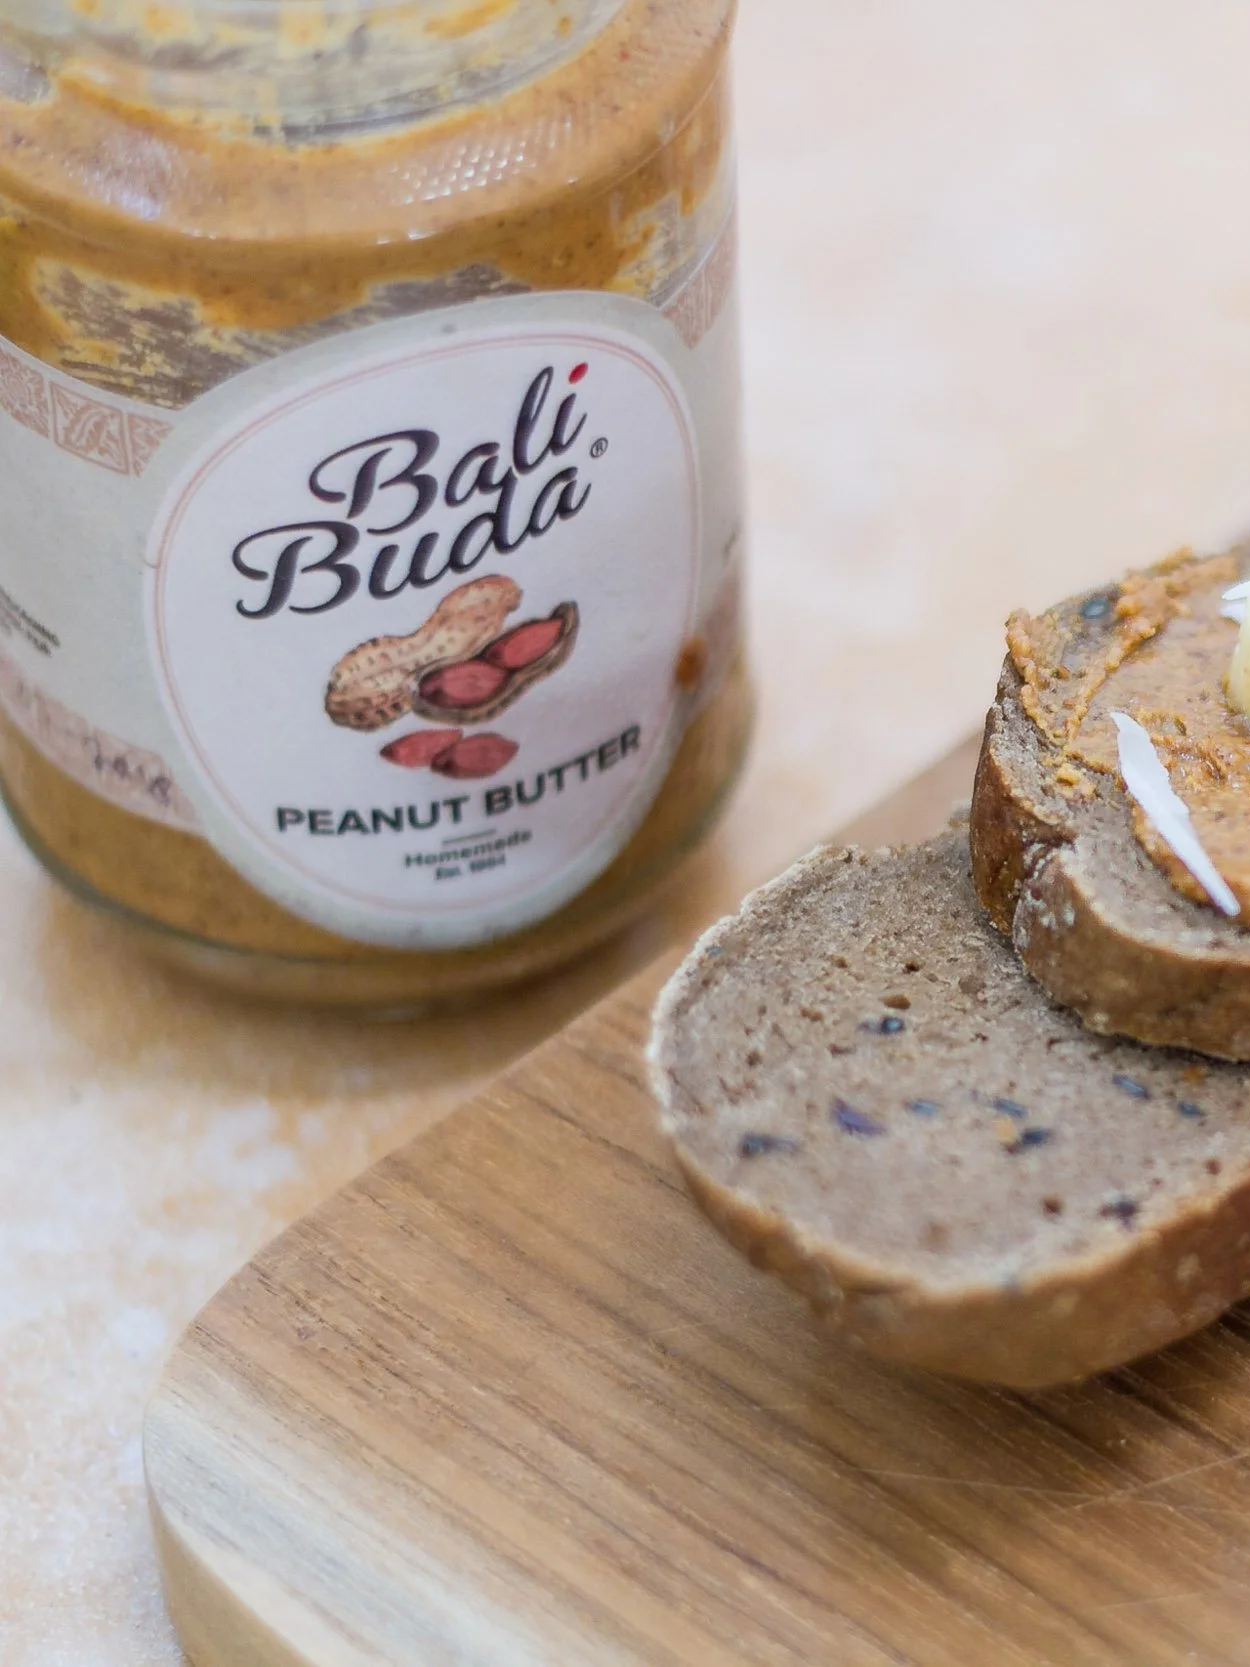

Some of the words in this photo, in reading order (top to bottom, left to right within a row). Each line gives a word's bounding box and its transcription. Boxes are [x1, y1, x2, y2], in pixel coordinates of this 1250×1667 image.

[310, 363, 588, 533] Bali
[232, 467, 591, 619] Buda
[276, 795, 471, 836] PEANUT
[484, 725, 640, 817] BUTTER
[405, 830, 532, 867] Homemade
